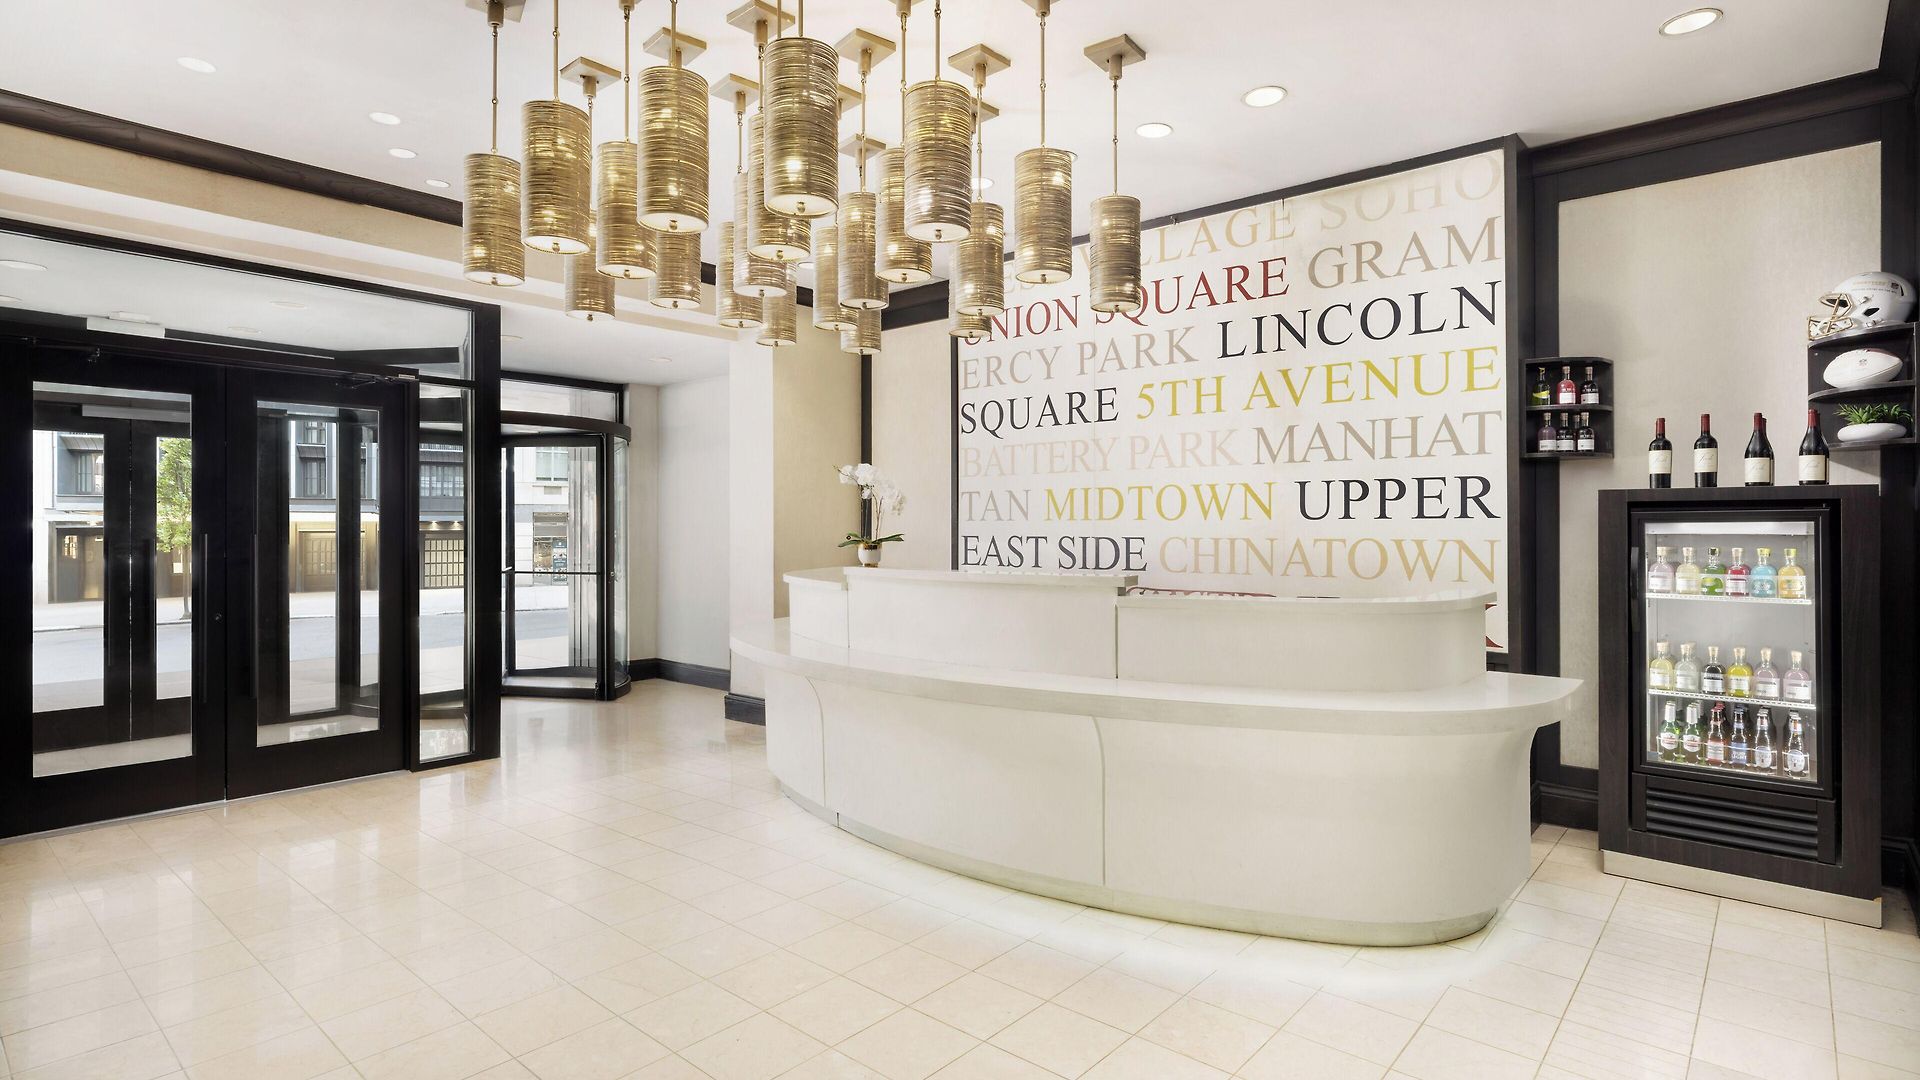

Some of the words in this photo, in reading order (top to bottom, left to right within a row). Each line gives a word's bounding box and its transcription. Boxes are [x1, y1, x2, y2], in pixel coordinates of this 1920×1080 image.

[1079, 200, 1296, 272] LAGE
[1320, 155, 1501, 232] SOHO
[964, 294, 1080, 346] NION
[1095, 256, 1289, 327] QUARE
[1308, 215, 1502, 289] GRAM
[962, 346, 1062, 390] ERCY
[1076, 326, 1199, 376] PARK
[1217, 280, 1502, 359] LINCOLN
[960, 387, 1119, 439] SQUARE
[1136, 376, 1225, 420] 5TH
[1243, 345, 1502, 411] AVENUE
[962, 437, 1118, 478] BATTERY
[1127, 428, 1243, 471] PARK
[1252, 411, 1503, 465] MANHAT
[962, 489, 1031, 522] TAN
[1044, 481, 1277, 521] MIDTOWN
[1294, 476, 1501, 520] UPPER
[962, 535, 1047, 568] EAST
[1058, 536, 1148, 571] SIDE
[1159, 536, 1501, 584] CHINATOWN
